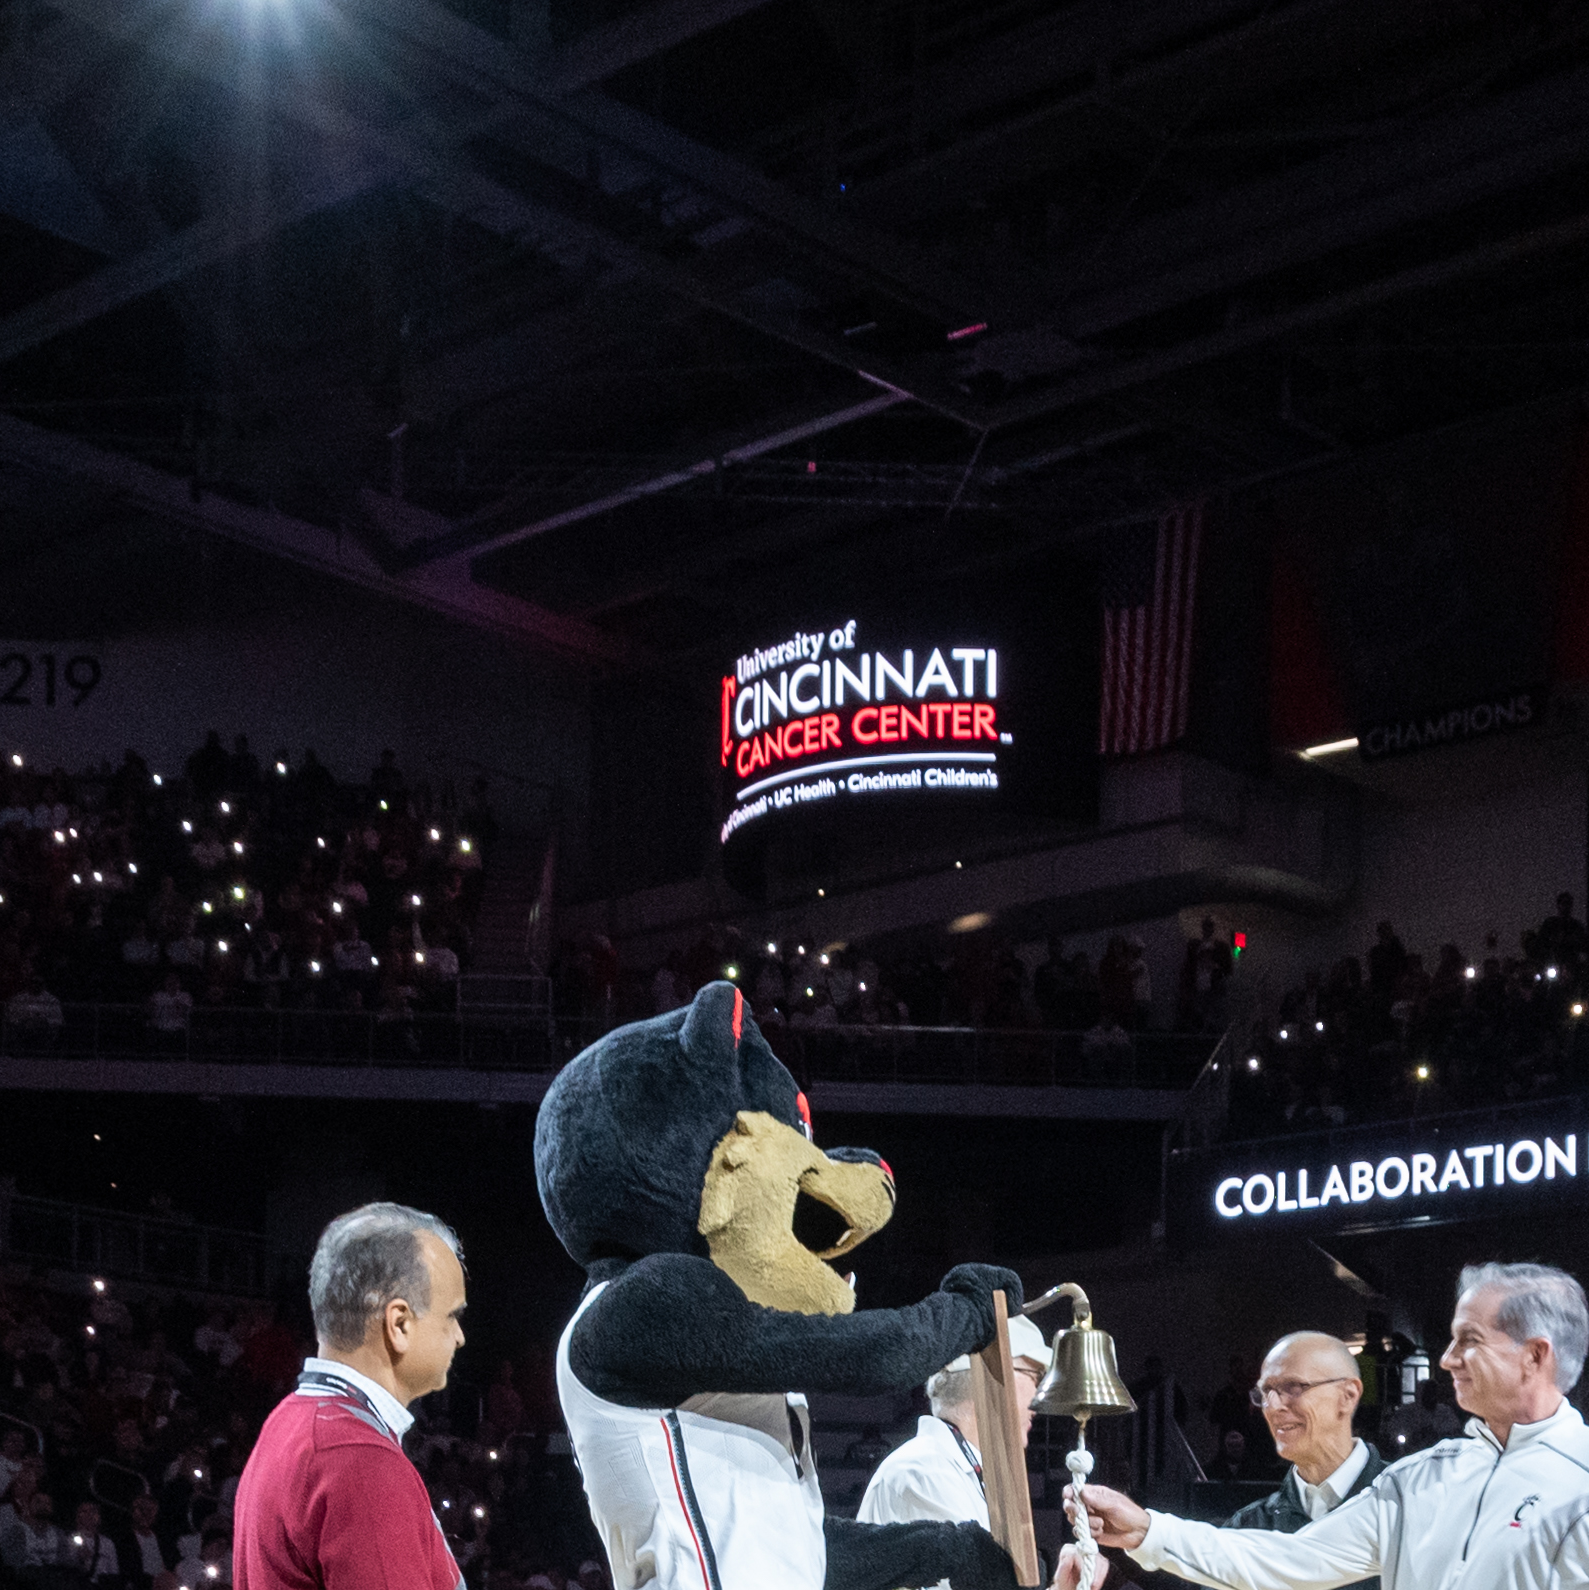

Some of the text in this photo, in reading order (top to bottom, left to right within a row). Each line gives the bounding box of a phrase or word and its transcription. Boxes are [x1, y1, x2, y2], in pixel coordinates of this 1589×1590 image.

[0, 652, 101, 706] 219
[737, 620, 856, 685] University of
[735, 647, 998, 738] CINCINNATI
[736, 713, 842, 778] CANCER
[851, 703, 998, 745] CENTER
[1364, 695, 1533, 757] CHAMPIONS
[774, 786, 793, 809] UC
[794, 777, 836, 803] Health
[847, 768, 922, 794] Cincinnati
[924, 767, 999, 789] Children's
[1214, 1134, 1578, 1218] COLLABORATION
